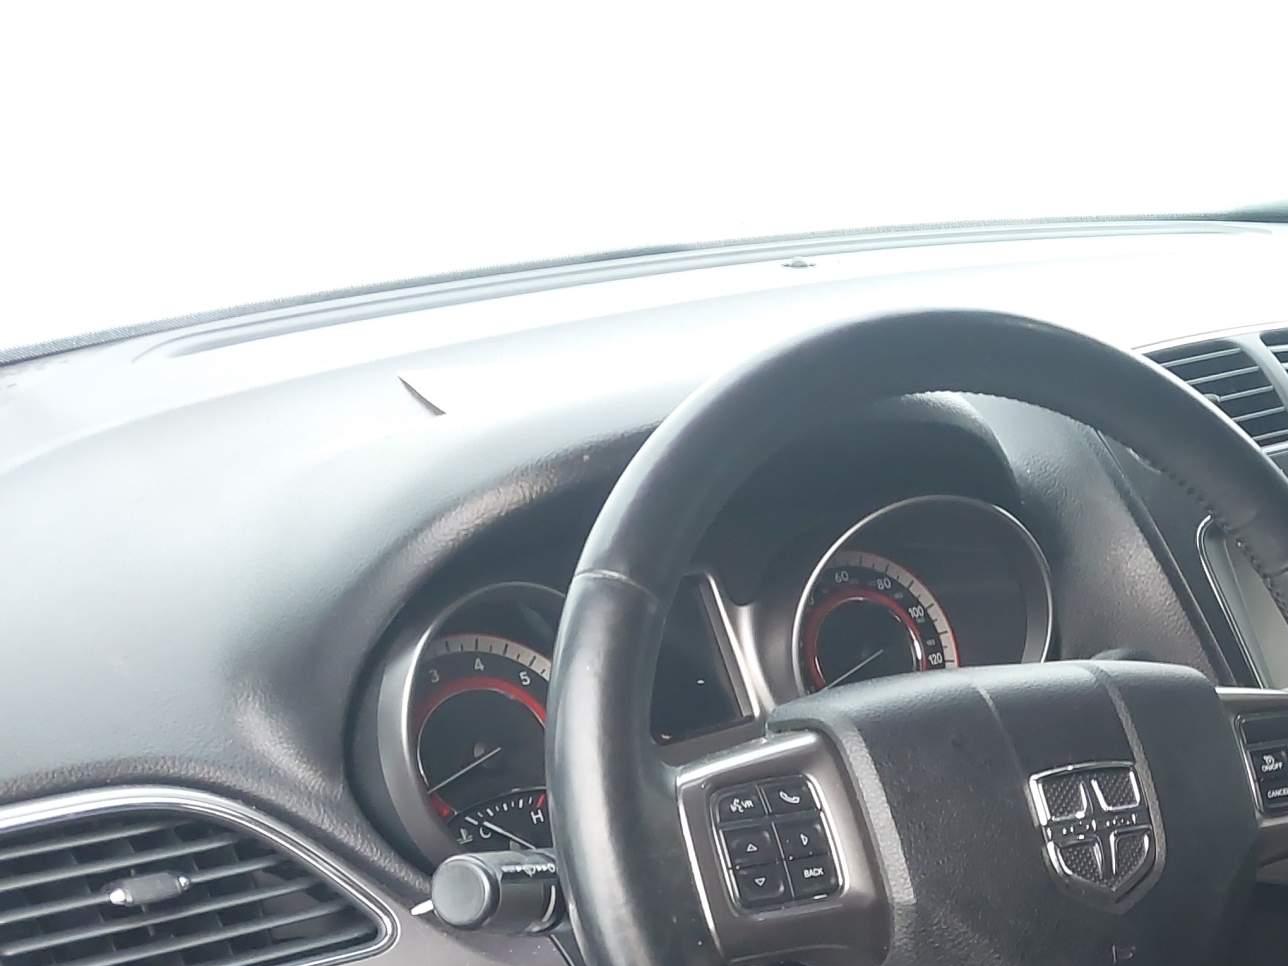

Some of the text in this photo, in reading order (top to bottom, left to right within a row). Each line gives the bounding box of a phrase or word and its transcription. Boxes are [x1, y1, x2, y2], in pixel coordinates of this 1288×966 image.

[835, 570, 849, 583] 60
[877, 577, 892, 590] 80
[908, 605, 925, 619] 100
[474, 657, 485, 672] 4
[928, 652, 943, 666] 120
[429, 669, 440, 683] 3
[519, 671, 531, 685] 5
[530, 808, 545, 825] H
[803, 867, 824, 878] BACK
